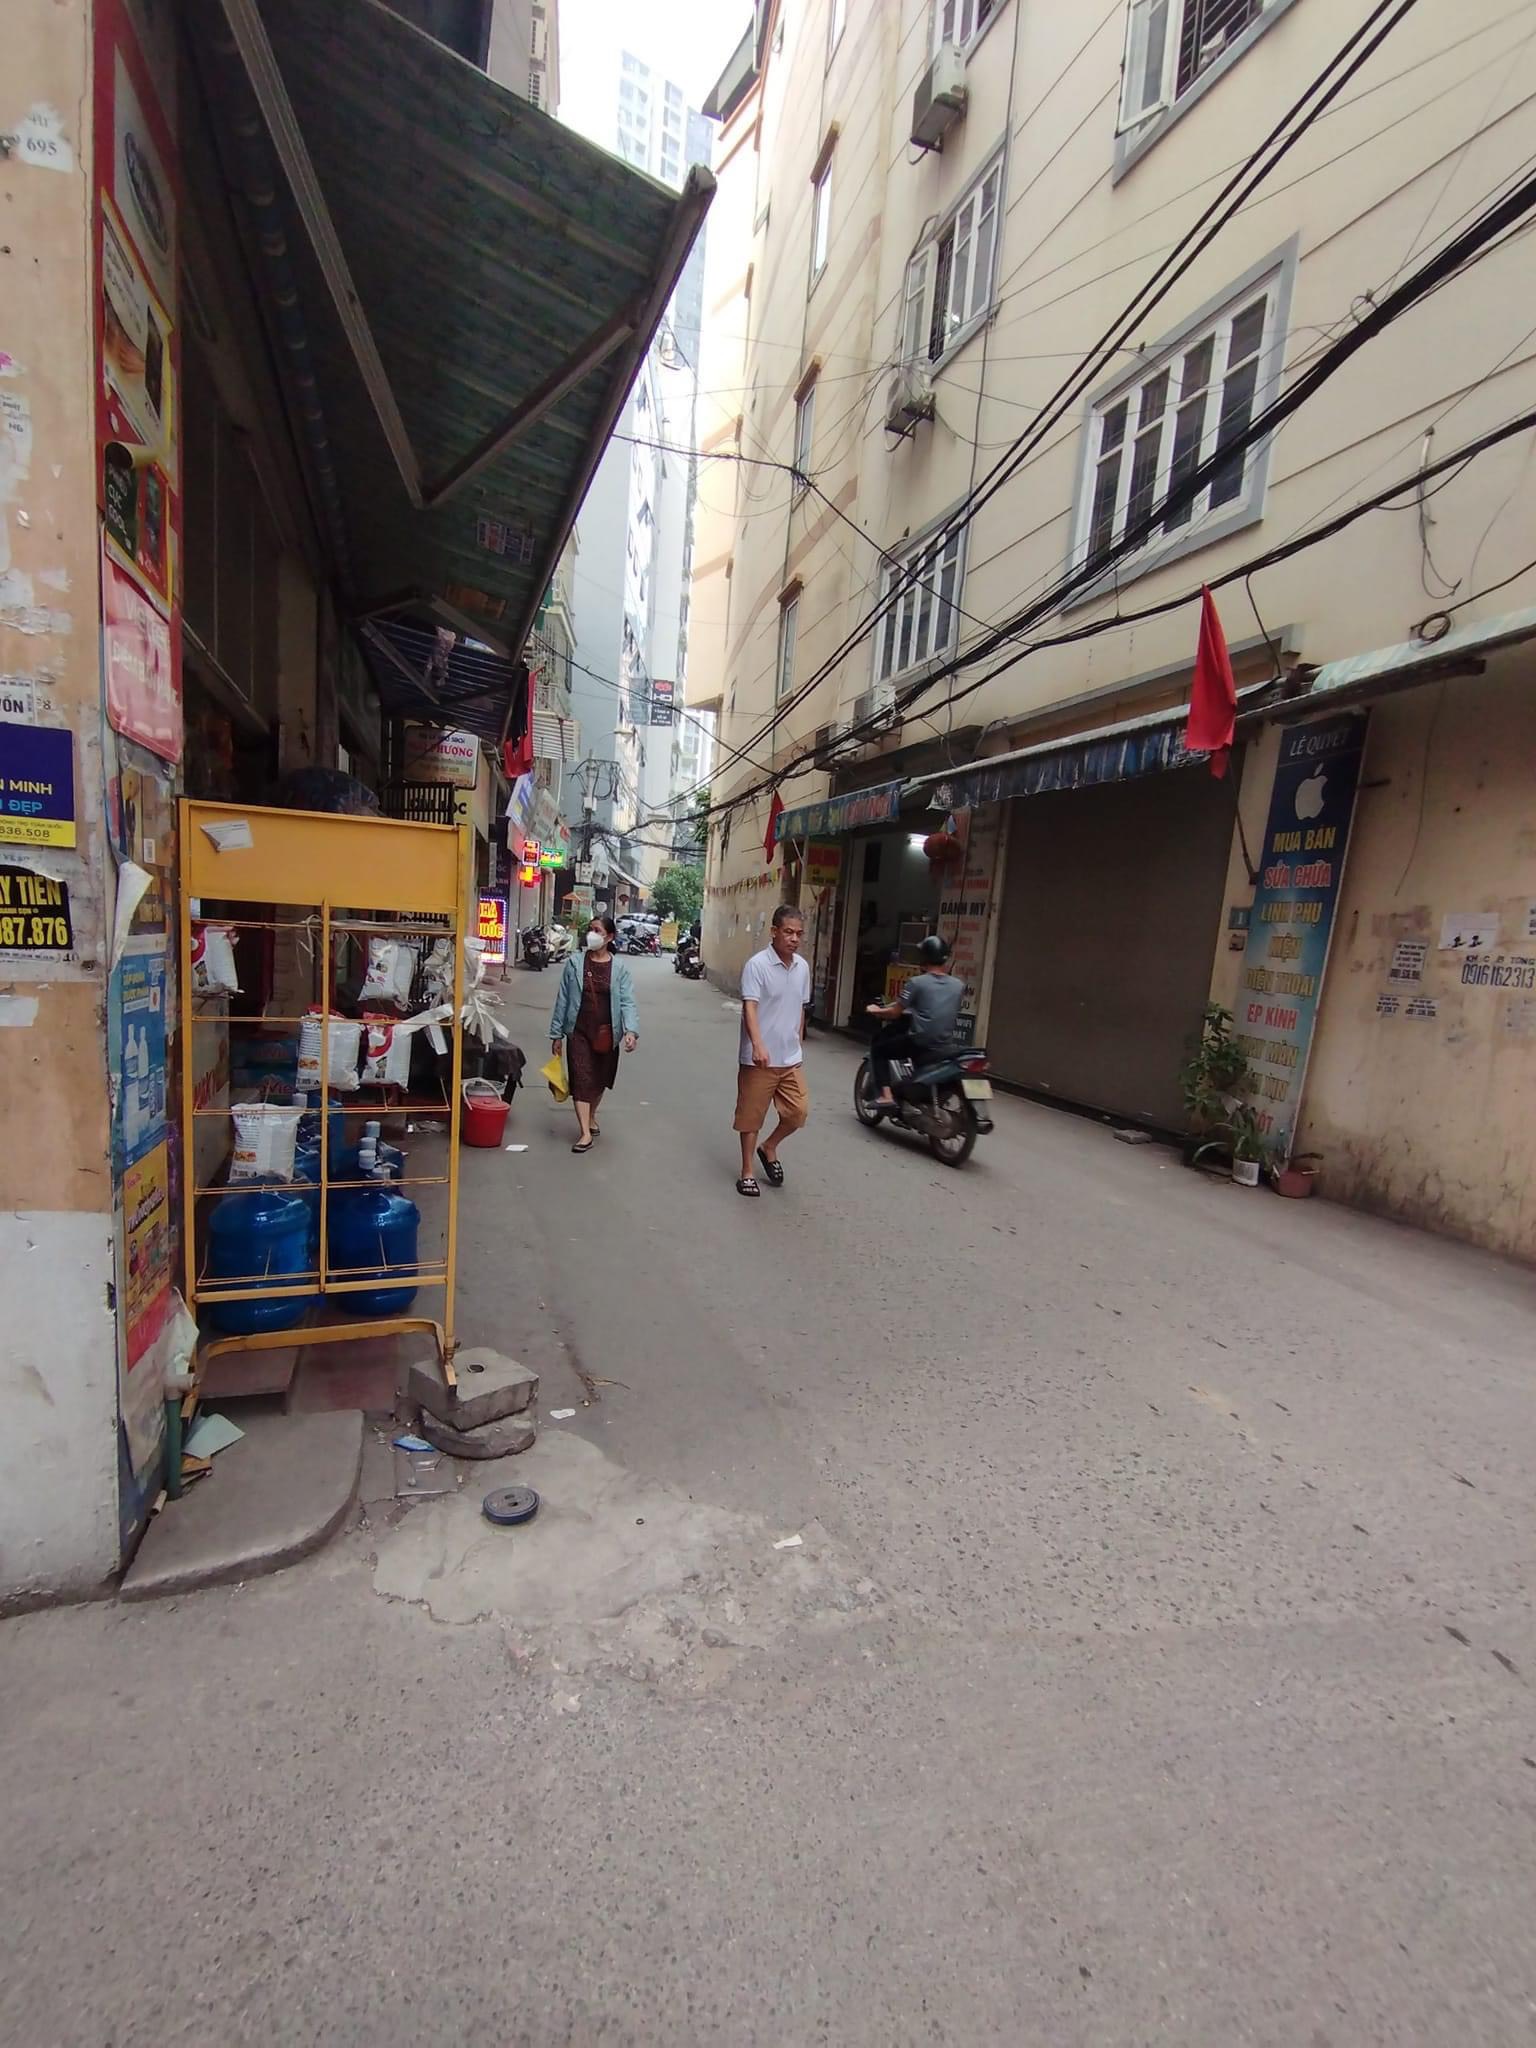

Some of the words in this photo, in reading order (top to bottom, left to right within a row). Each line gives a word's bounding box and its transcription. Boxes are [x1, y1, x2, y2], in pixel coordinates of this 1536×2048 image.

[9, 779, 53, 796] MINH
[8, 799, 43, 815] ĐẸP
[1272, 831, 1301, 853] MUA
[0, 917, 68, 946] 87.876
